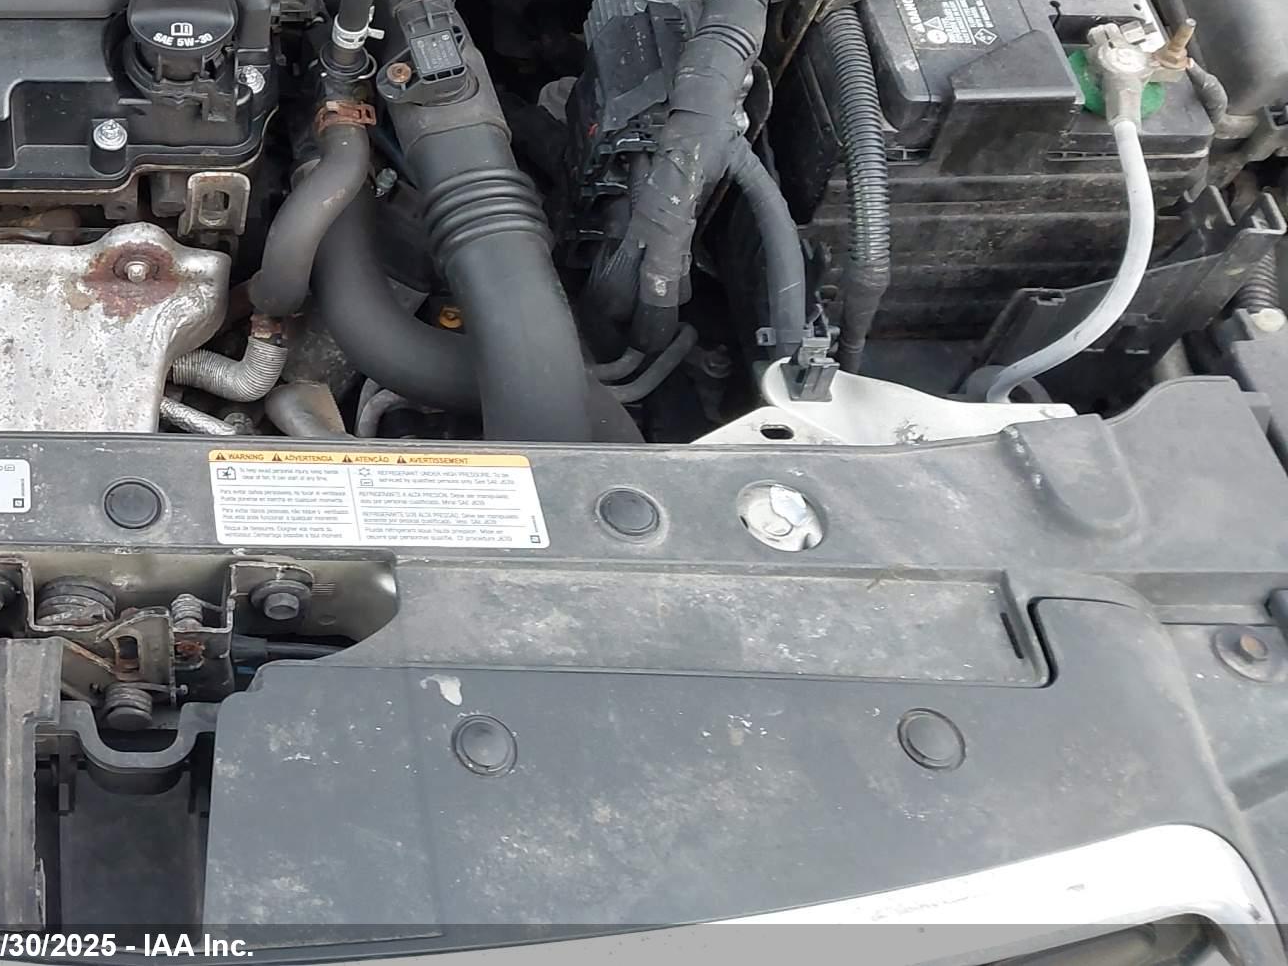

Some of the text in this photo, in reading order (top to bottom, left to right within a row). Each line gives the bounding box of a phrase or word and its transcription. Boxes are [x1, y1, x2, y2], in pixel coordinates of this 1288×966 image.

[152, 32, 214, 47] SAE 5W-30
[228, 453, 264, 461] WARNING
